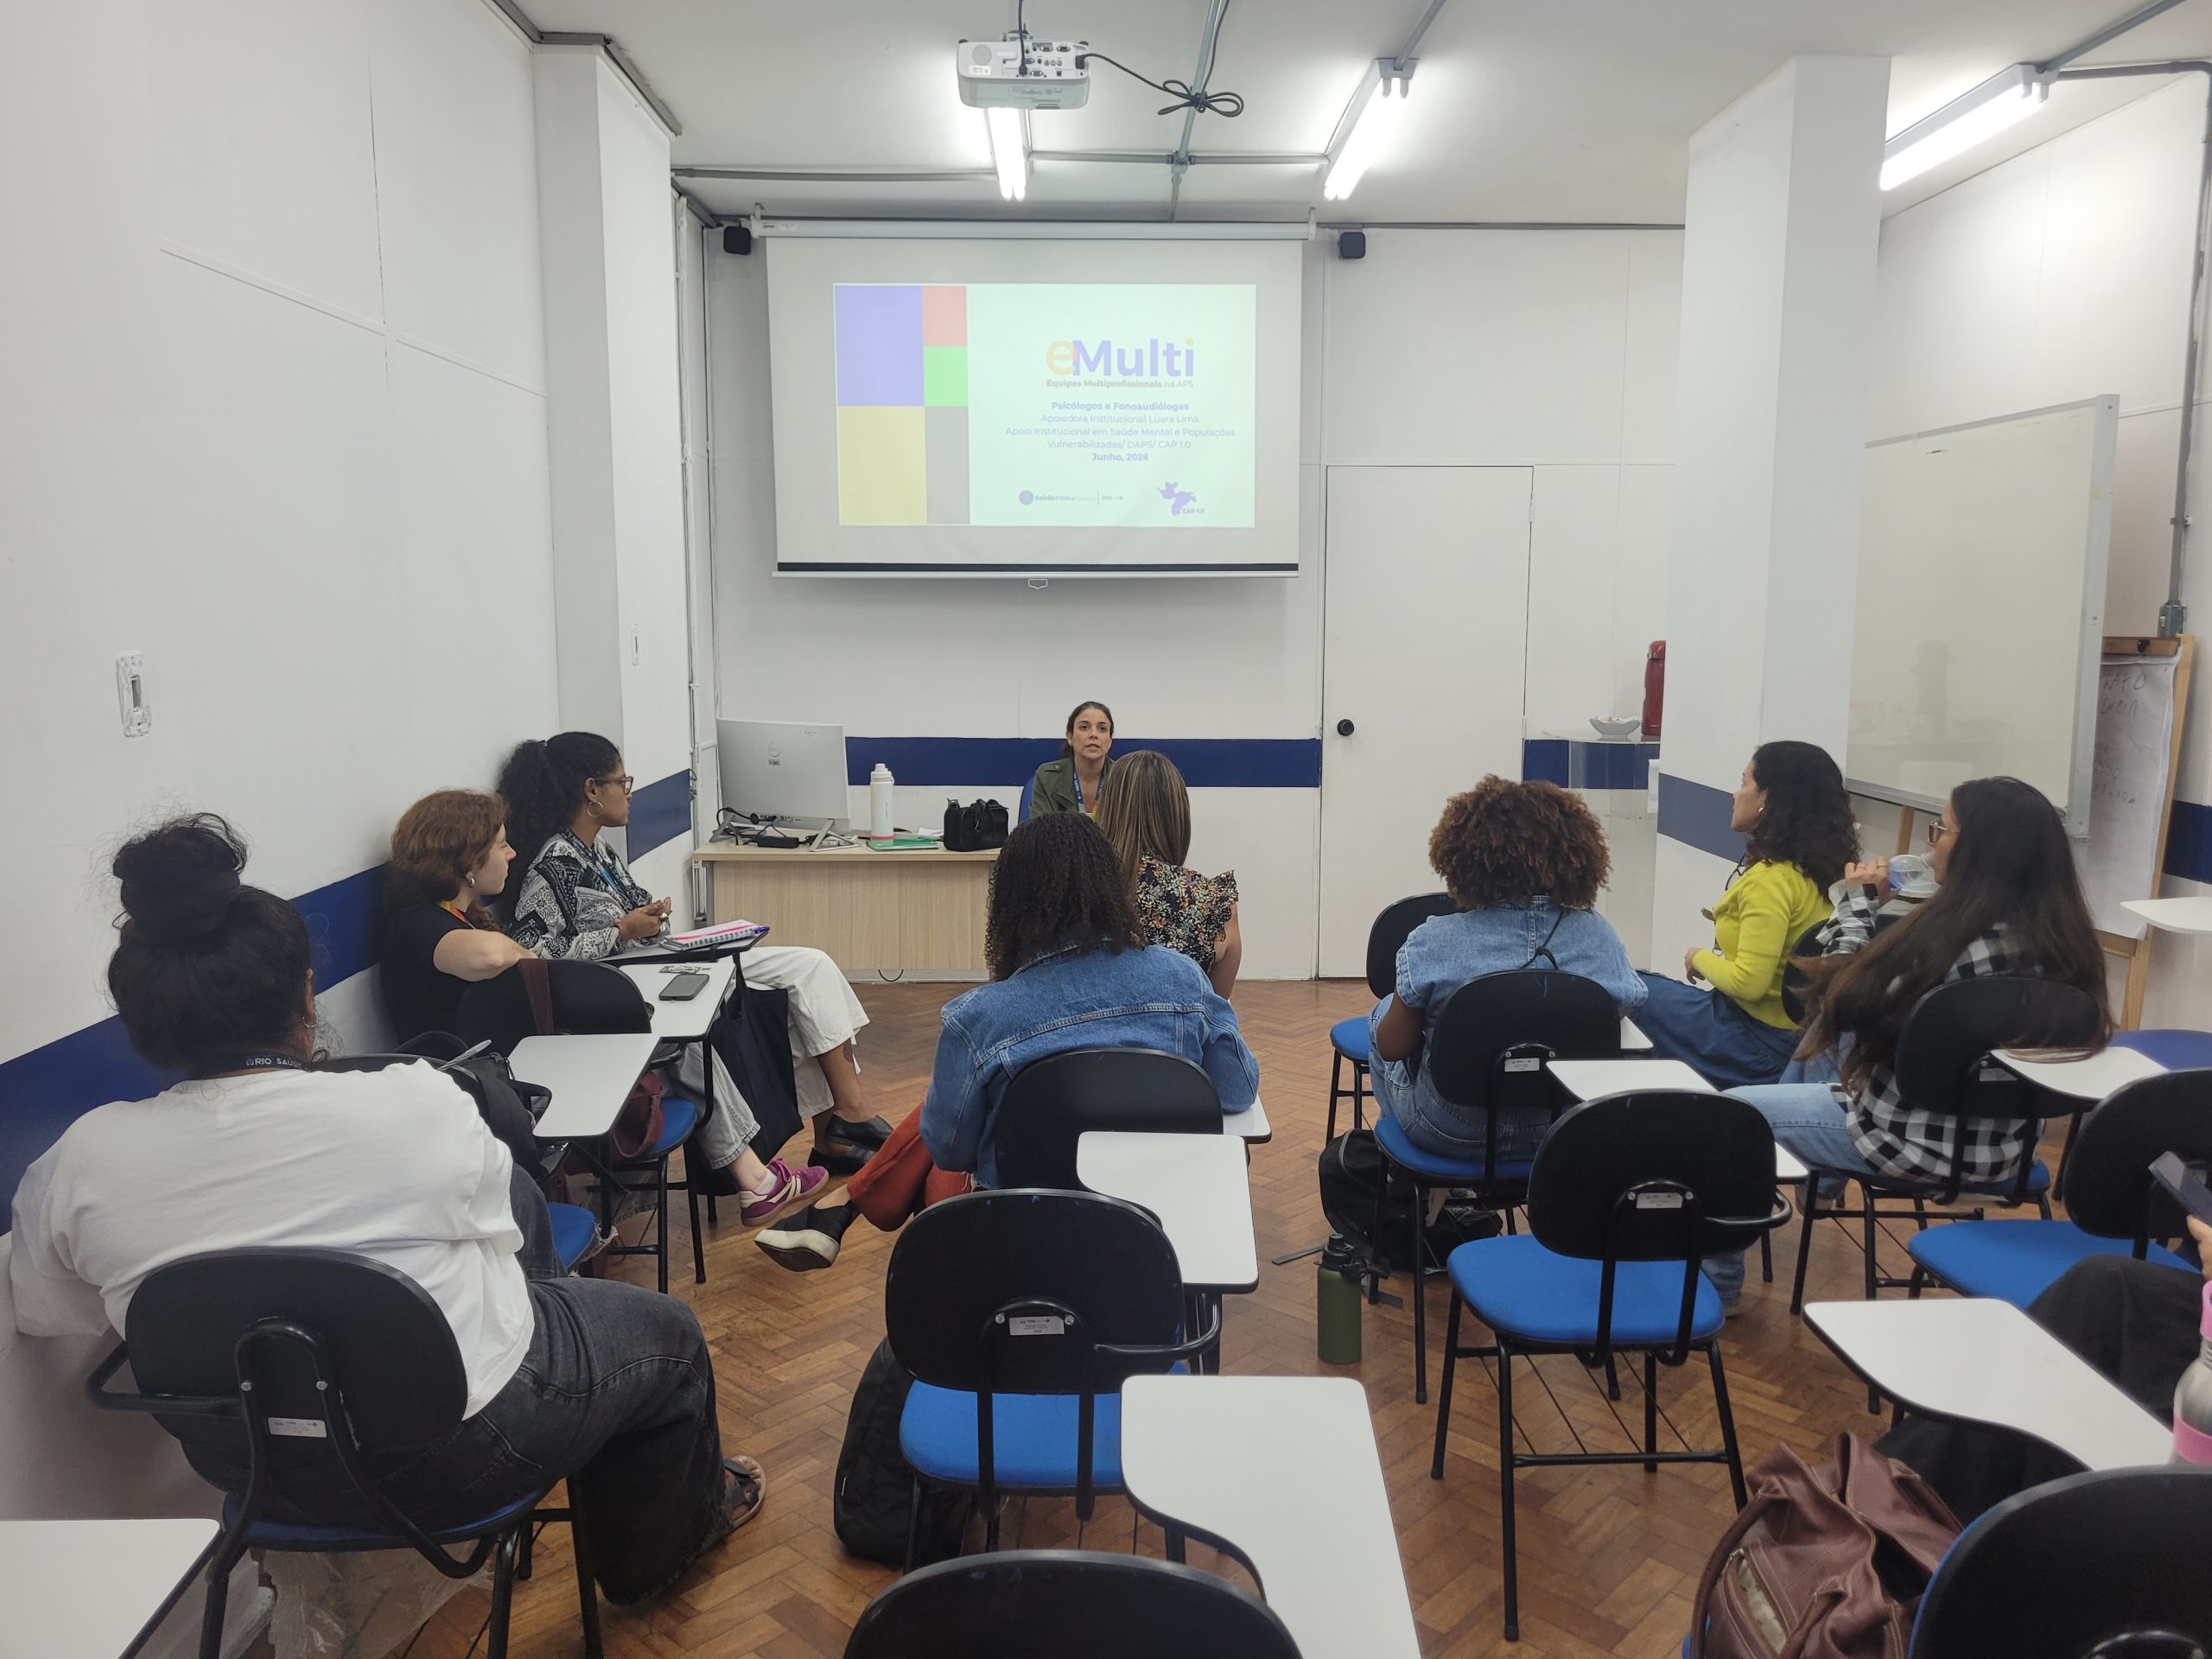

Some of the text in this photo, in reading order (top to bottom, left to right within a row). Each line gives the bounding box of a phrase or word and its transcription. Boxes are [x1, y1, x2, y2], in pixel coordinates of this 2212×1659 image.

[1046, 337, 1194, 377] eMulti
[1046, 379, 1082, 389] Equipes
[1084, 378, 1162, 389] Multiprofissionais
[1052, 401, 1103, 411] Psicólogos
[1113, 402, 1190, 412] Fonoaudiólogas
[1040, 415, 1199, 424] Apoiadora Institucional Luara Lima
[1005, 427, 1033, 436] Apoio
[1034, 427, 1090, 435] Institucional
[1109, 428, 1139, 436] Saúde
[1141, 428, 1173, 436] Mental
[1182, 428, 1236, 438] Populações
[1127, 440, 1157, 449] DAPS/
[1091, 453, 1149, 461] Junho, 2026
